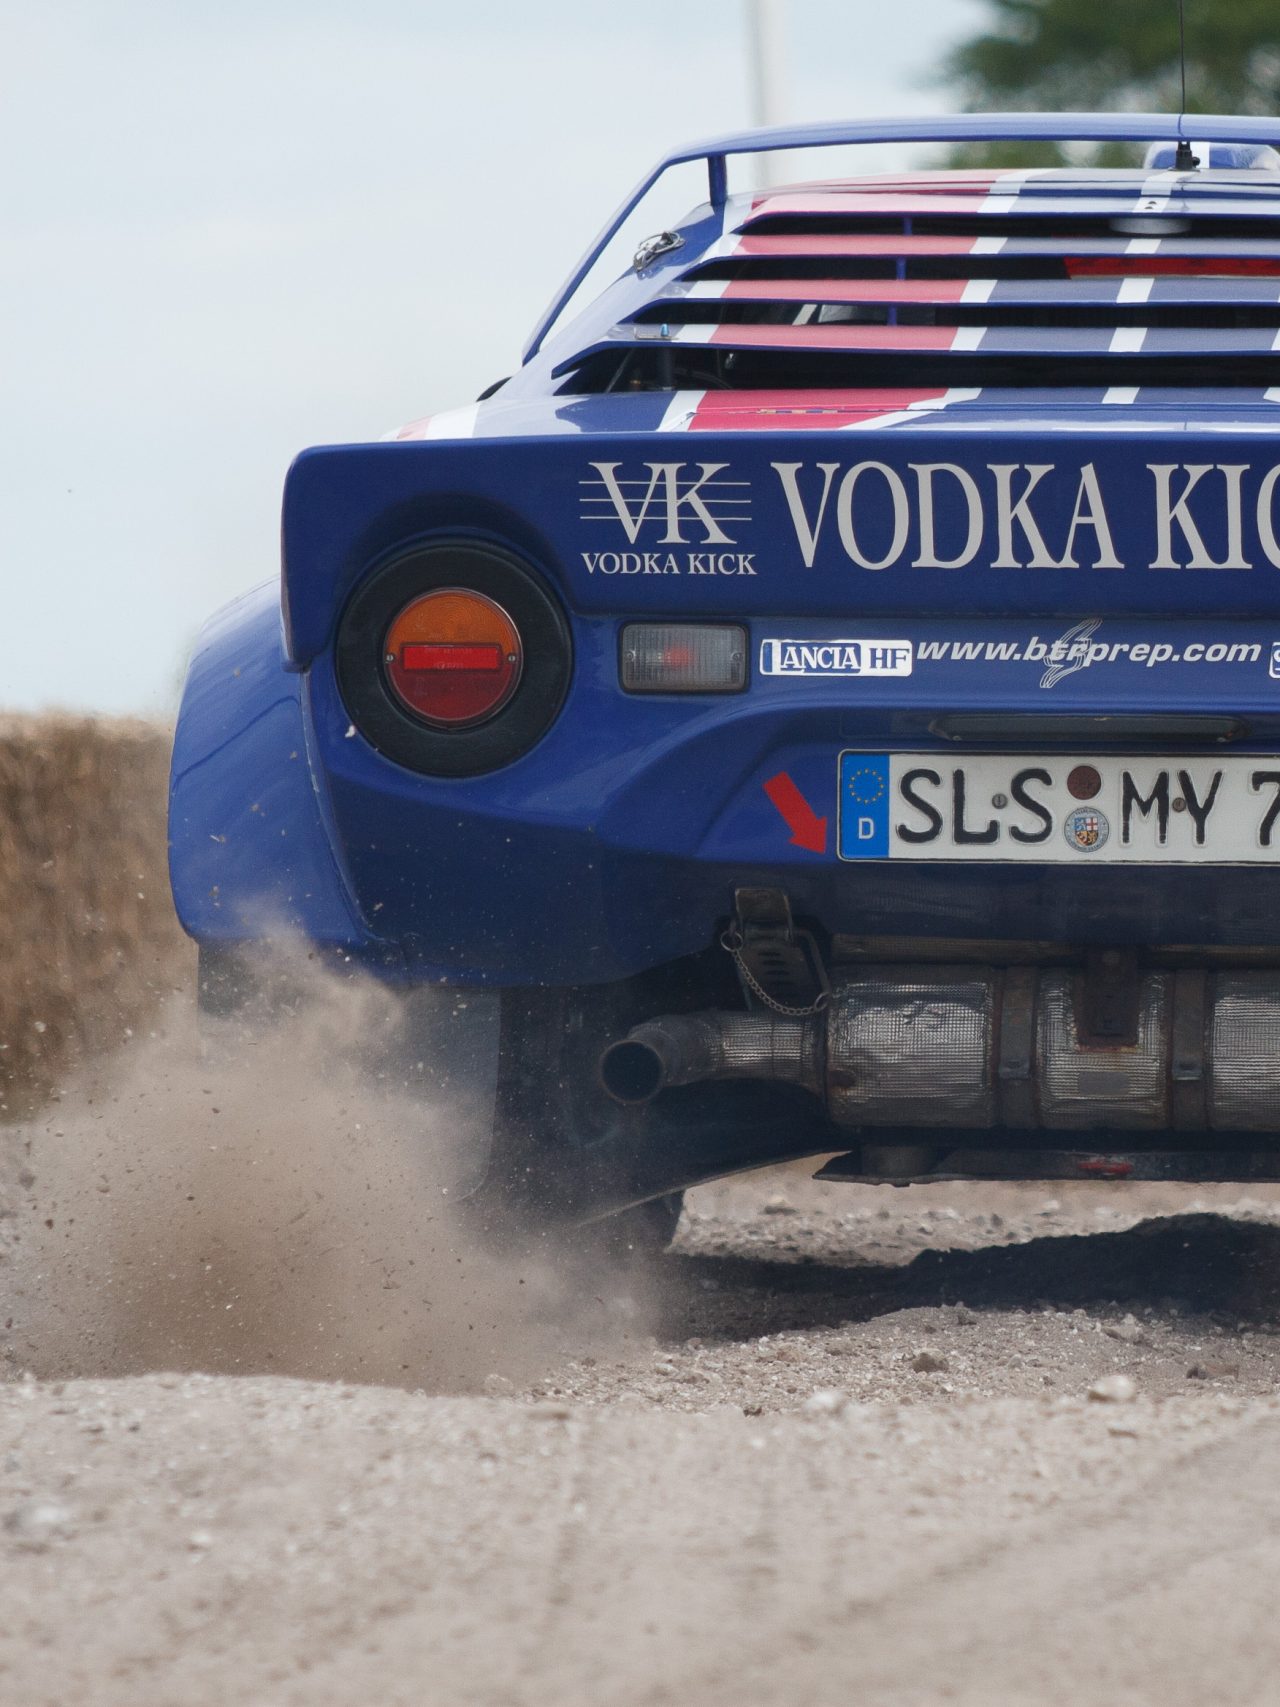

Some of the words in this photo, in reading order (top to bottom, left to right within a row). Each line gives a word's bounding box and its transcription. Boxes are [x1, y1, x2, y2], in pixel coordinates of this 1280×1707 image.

[588, 462, 737, 544] VK
[771, 461, 1124, 570] VODKA
[581, 552, 680, 574] VODKA
[687, 553, 757, 575] KICK
[869, 647, 910, 669] HF
[858, 817, 874, 839] D
[1122, 770, 1223, 844] MY
